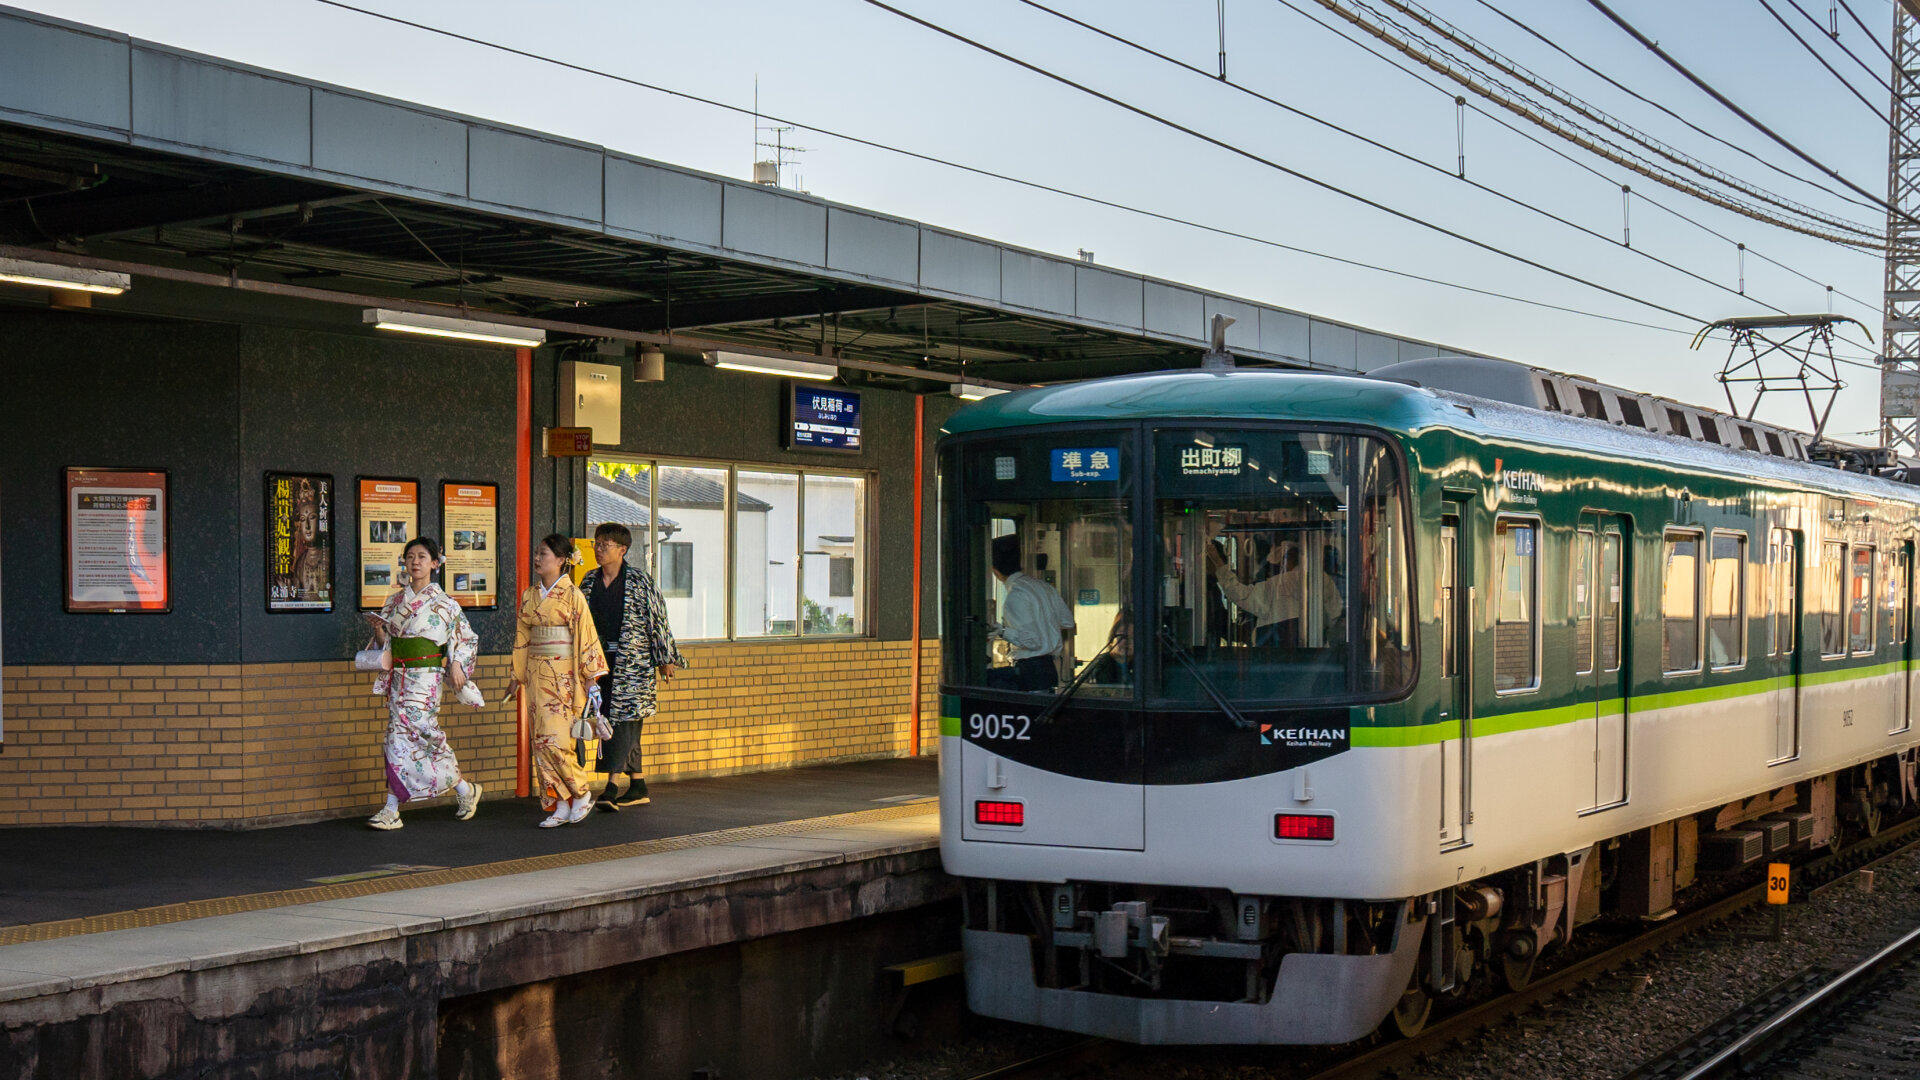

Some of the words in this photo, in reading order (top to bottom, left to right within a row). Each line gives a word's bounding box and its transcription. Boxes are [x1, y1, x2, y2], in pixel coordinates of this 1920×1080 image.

[812, 396, 843, 412] 伏見稲荷
[1182, 448, 1242, 468] 出町柳
[1070, 470, 1101, 478] Sub-exp.
[1182, 467, 1241, 476] Demachiyanagi
[969, 713, 1031, 740] 9052
[1273, 727, 1345, 740] KEIHAN
[1308, 740, 1332, 748] Railway
[1770, 876, 1787, 892] 30
